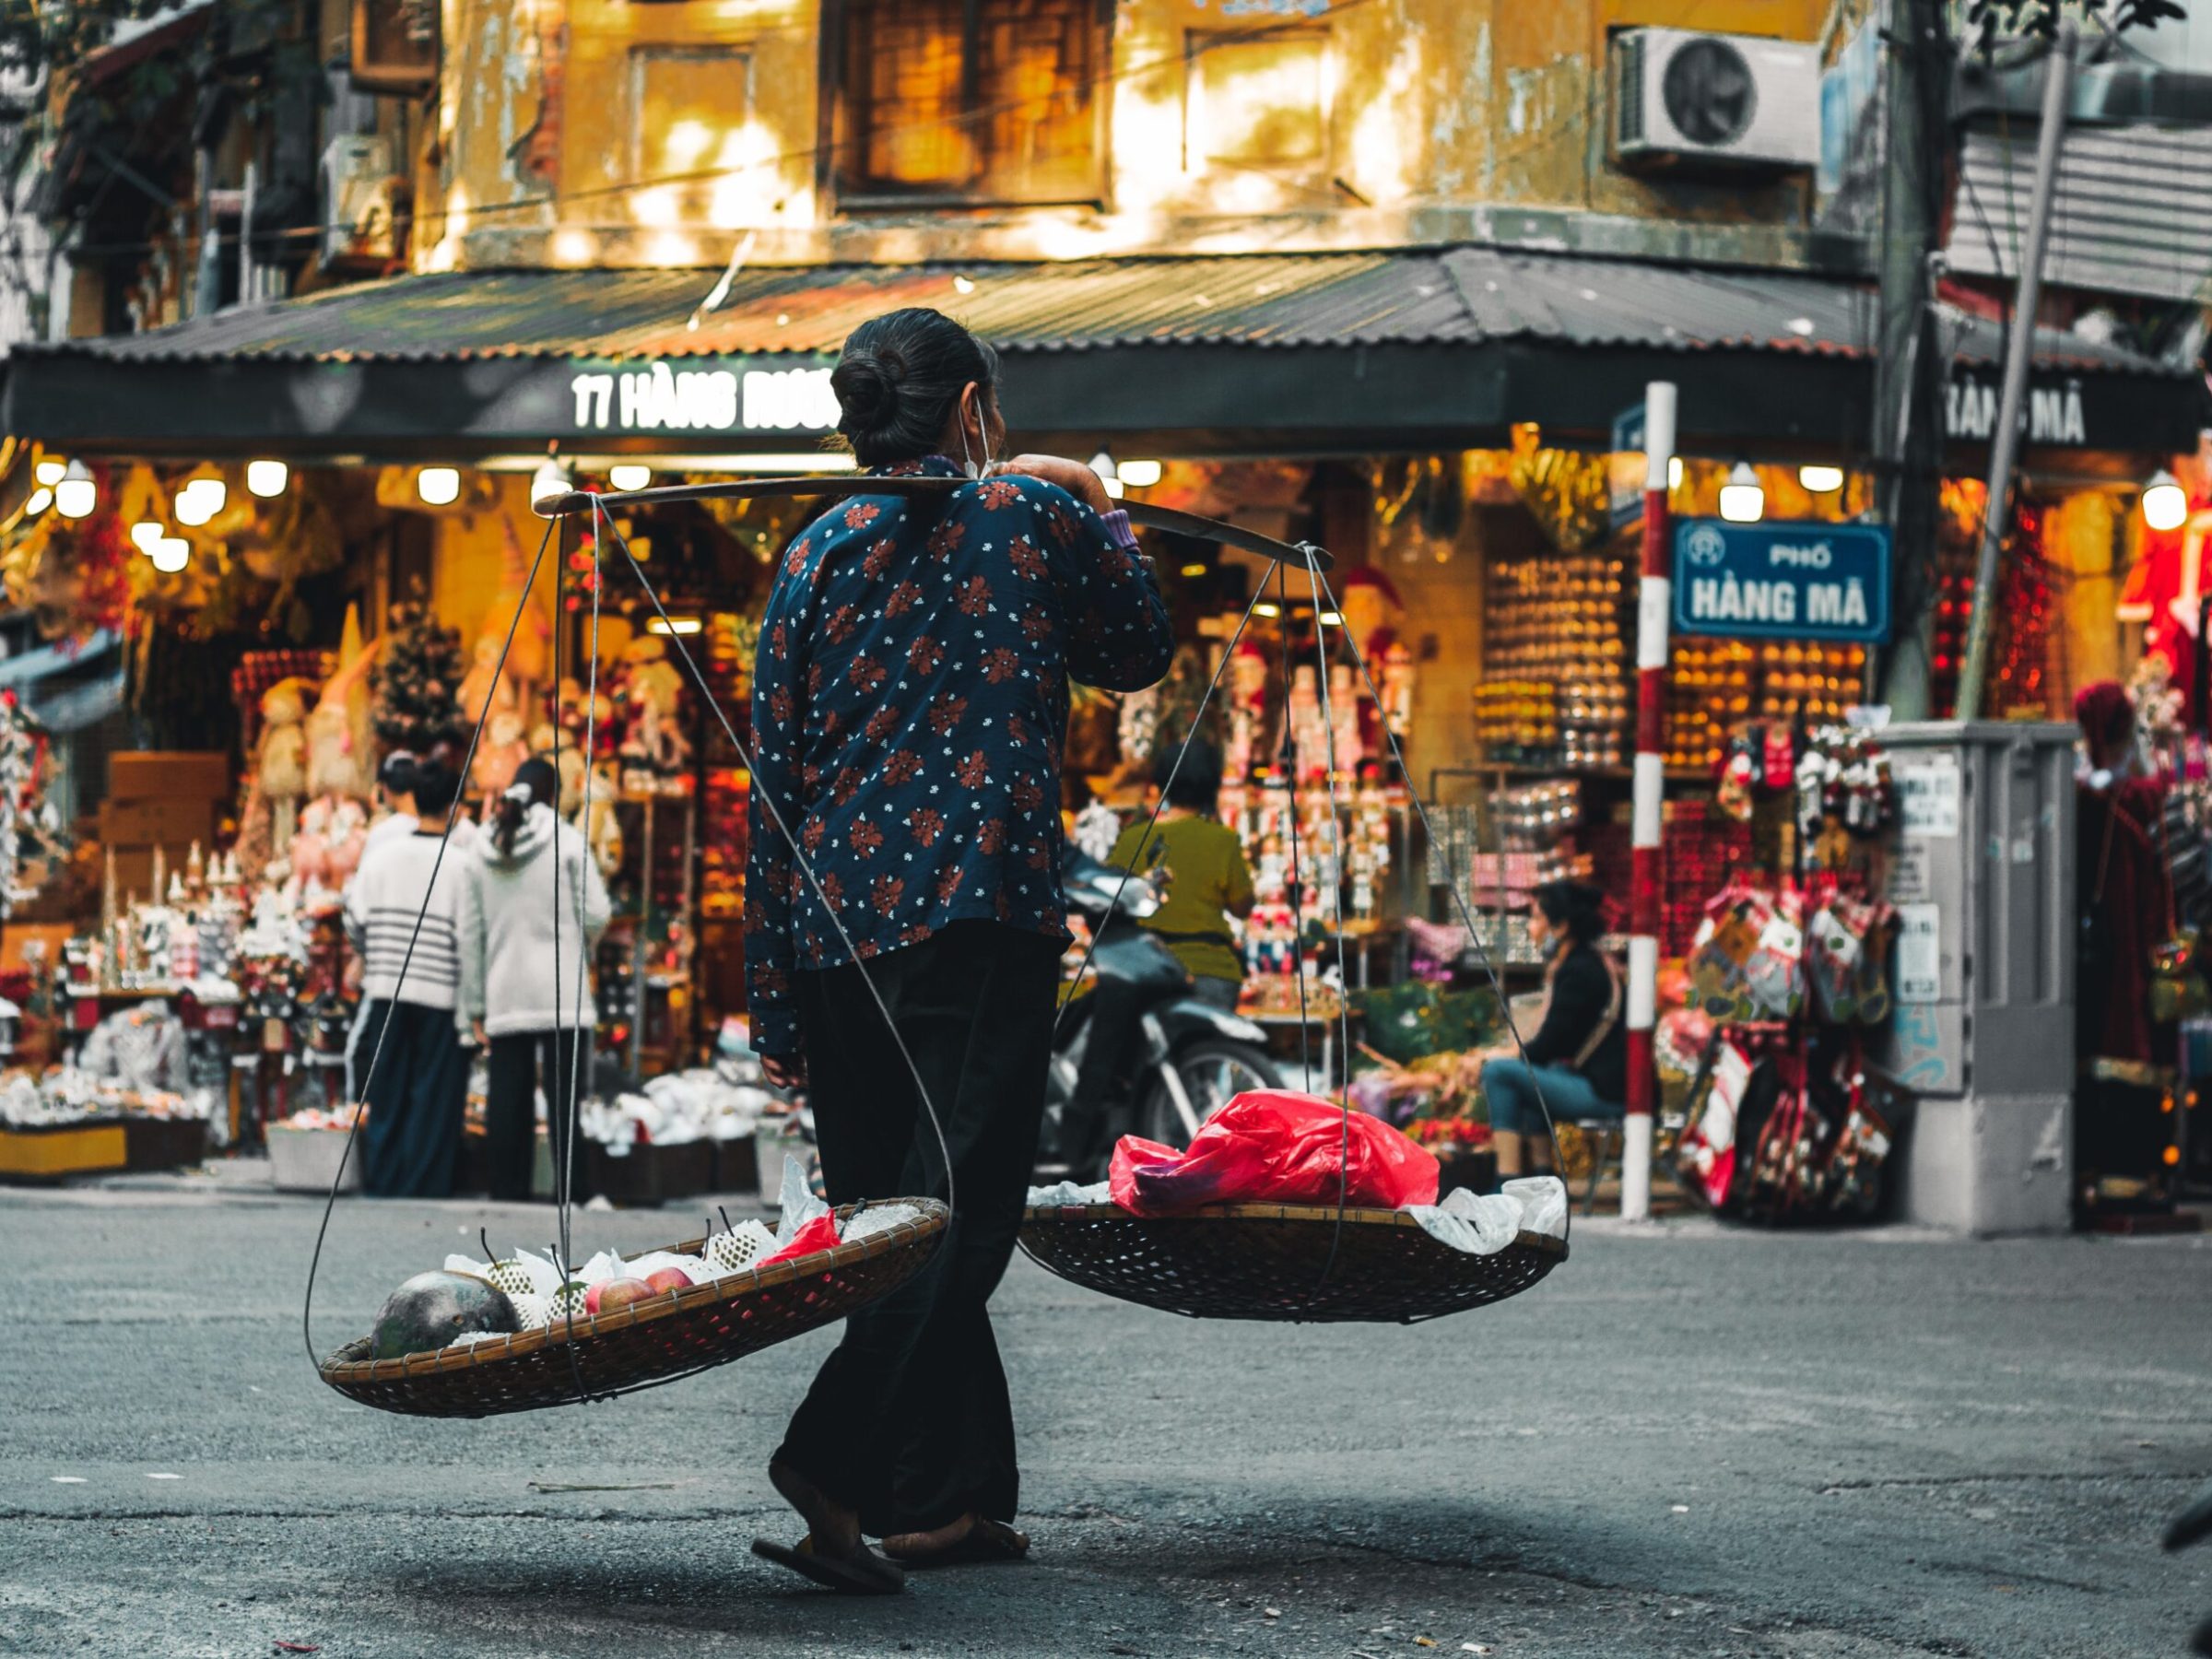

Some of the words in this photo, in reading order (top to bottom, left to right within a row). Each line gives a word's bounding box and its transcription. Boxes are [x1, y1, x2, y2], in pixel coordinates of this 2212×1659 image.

[572, 374, 613, 427] 17
[620, 362, 736, 428] HÀNG
[1691, 568, 1797, 622] HÀNG
[1806, 576, 1869, 626] MÃ
